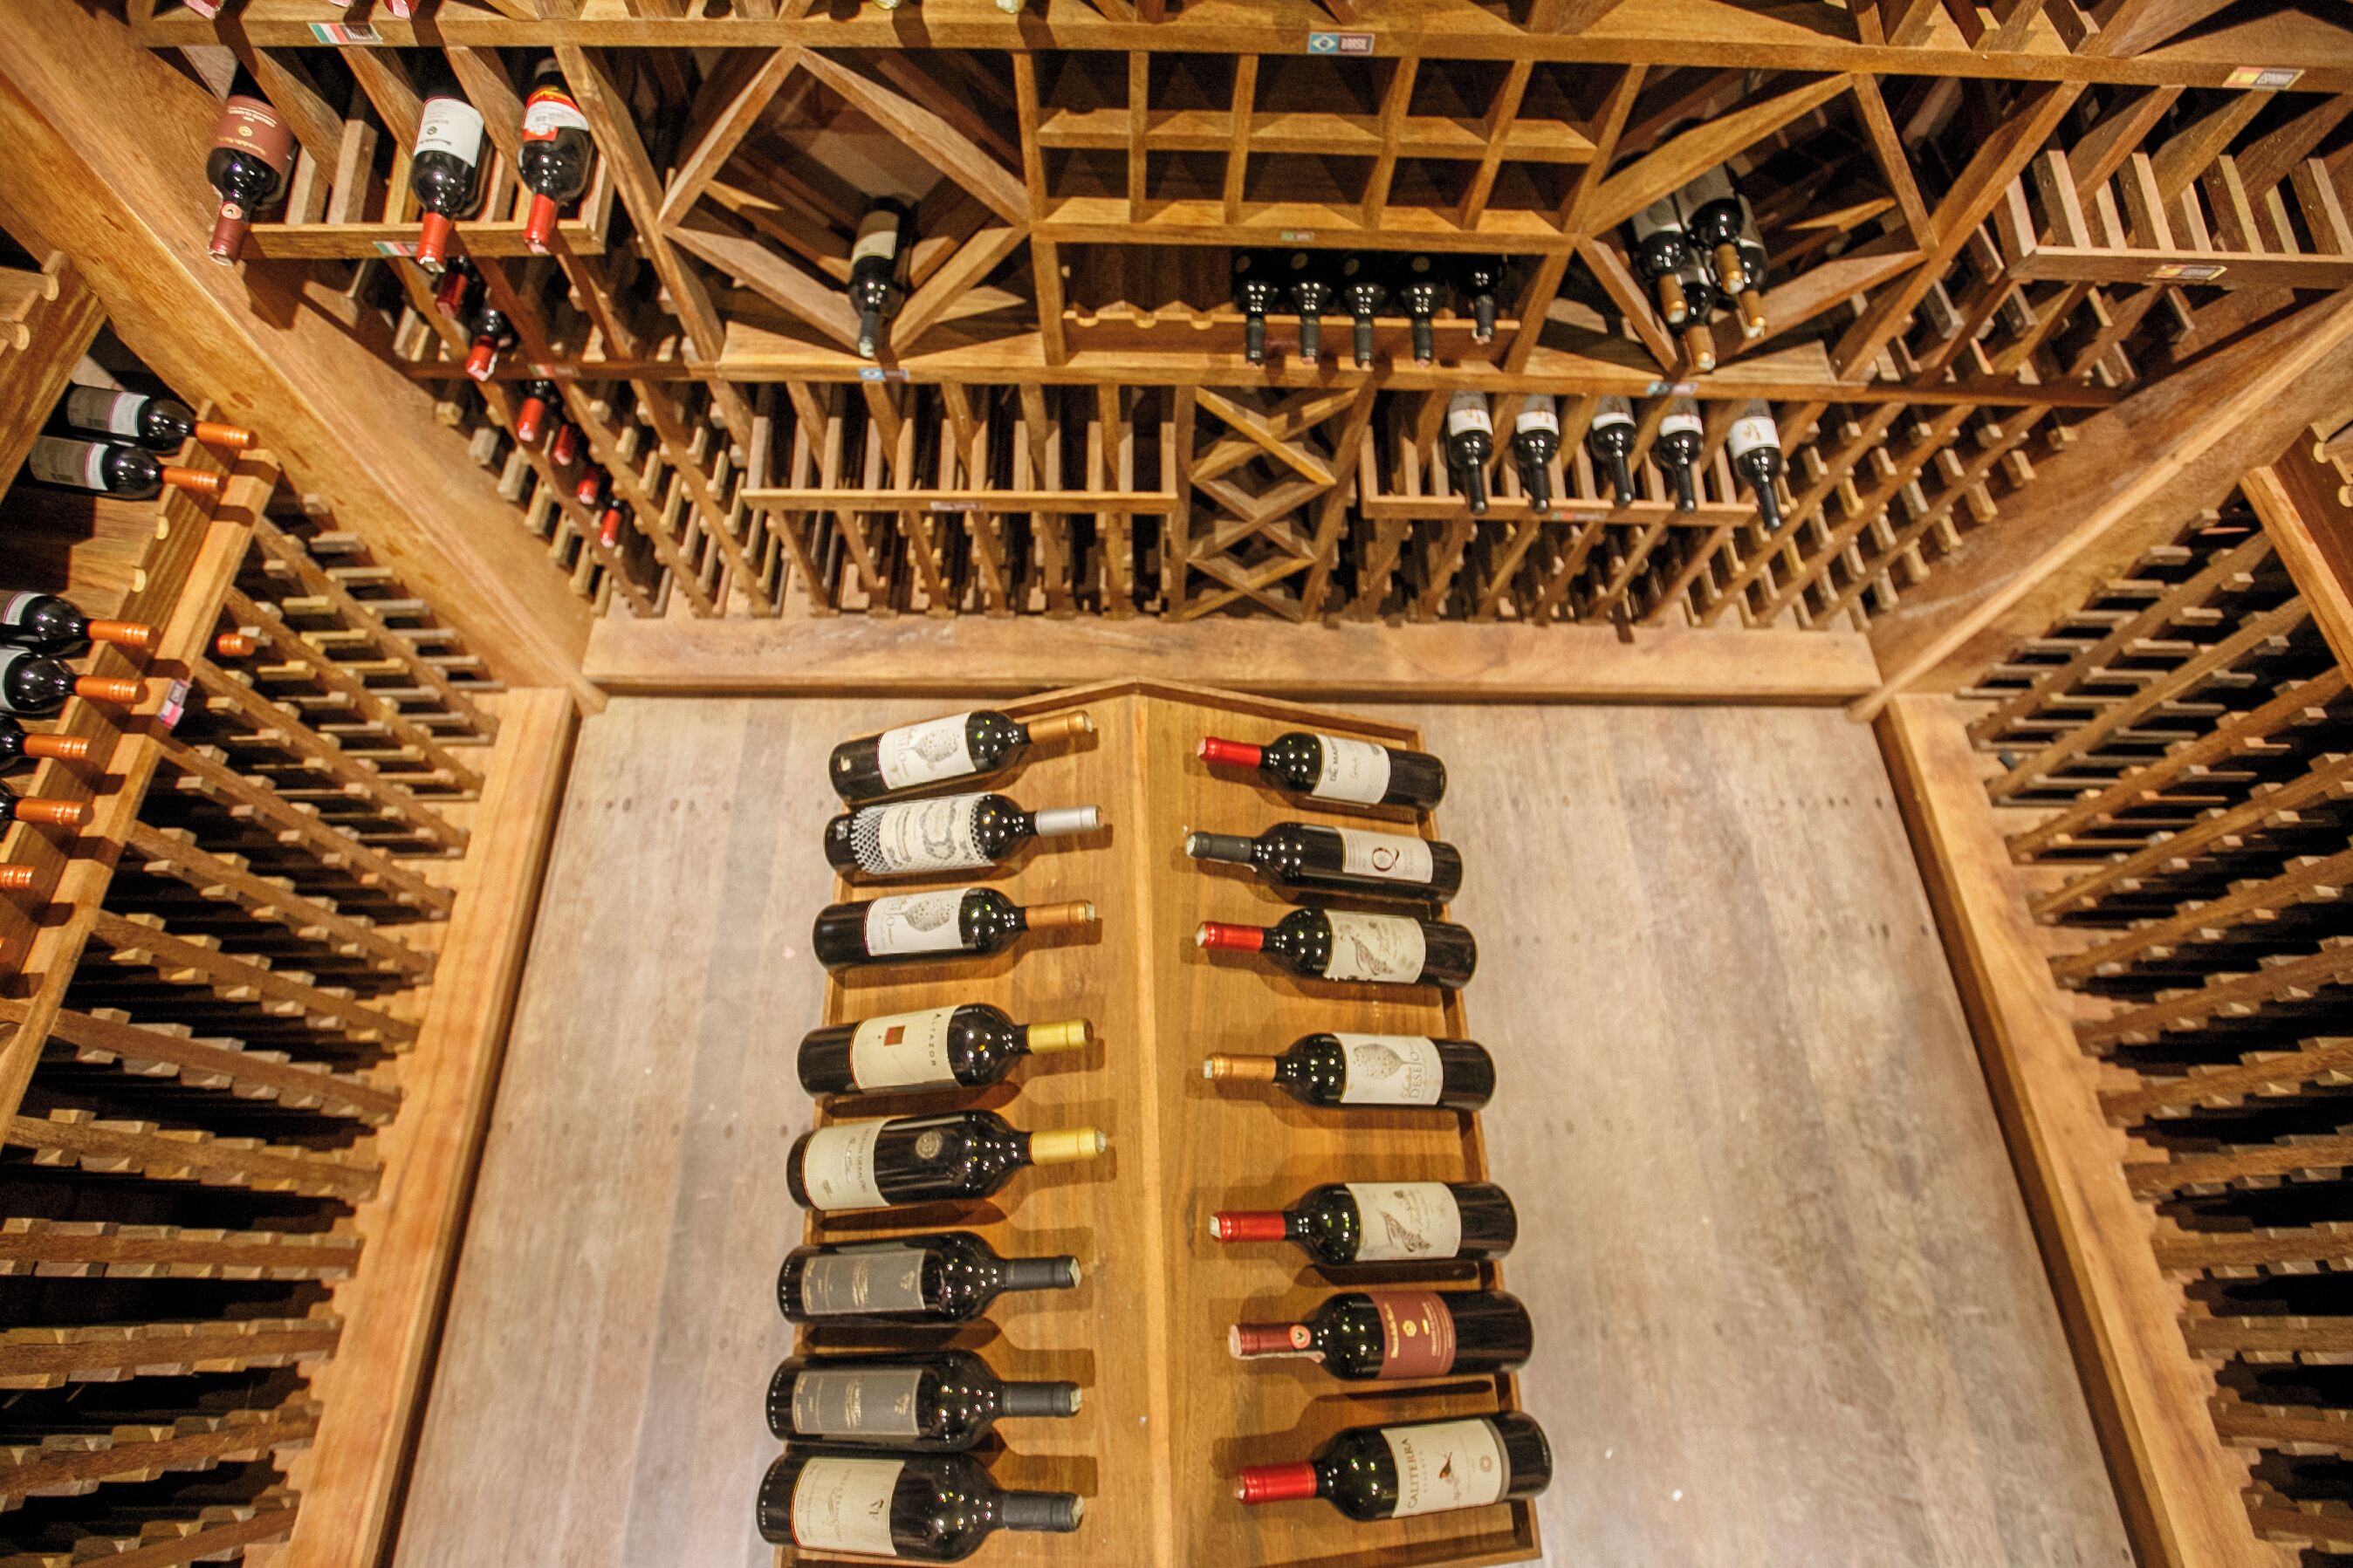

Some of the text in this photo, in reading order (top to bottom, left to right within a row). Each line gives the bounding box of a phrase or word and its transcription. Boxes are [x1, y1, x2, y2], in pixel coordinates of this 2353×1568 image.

[1329, 768, 1339, 782] DE
[1372, 846, 1400, 873] Q
[928, 1013, 943, 1067] ALTAZOR
[1400, 1438, 1420, 1509] CALITERRA
